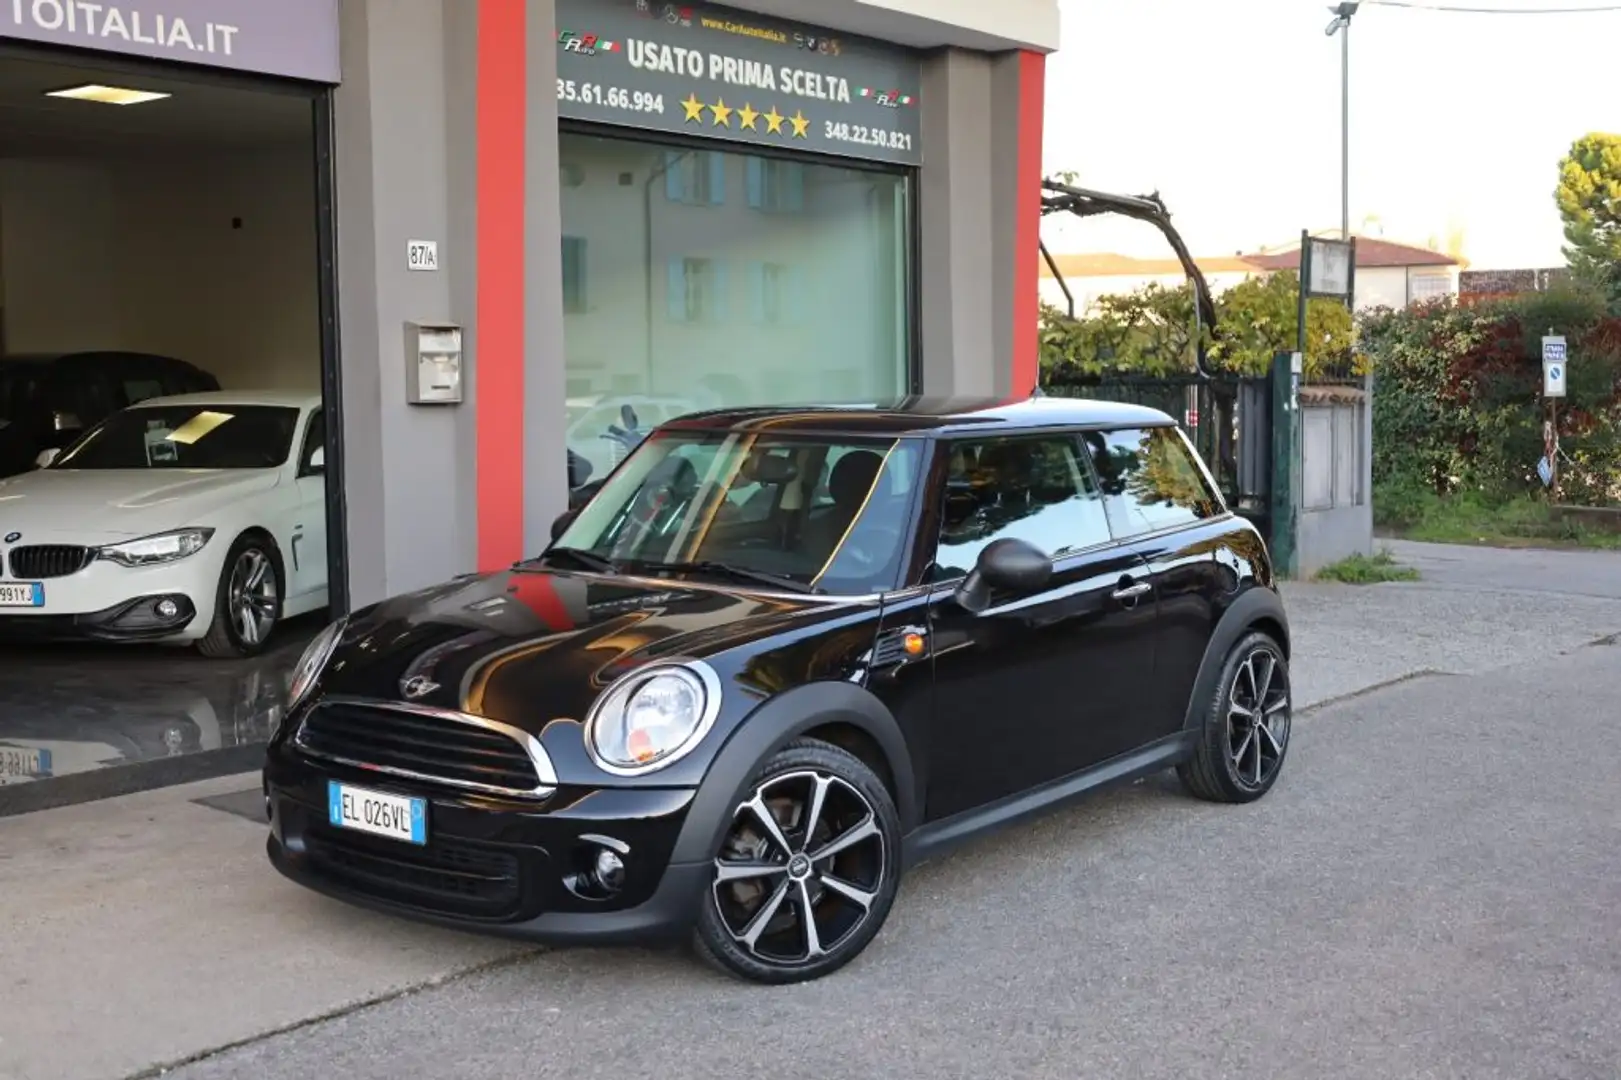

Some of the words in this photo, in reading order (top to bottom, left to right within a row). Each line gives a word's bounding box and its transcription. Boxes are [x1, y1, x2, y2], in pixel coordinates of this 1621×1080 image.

[627, 38, 704, 78] USATO
[709, 54, 776, 91] PRIMA
[780, 67, 851, 103] SCELTA
[824, 120, 912, 150] 348.22.50.821
[410, 246, 435, 265] 87/A
[342, 793, 360, 822] EL
[364, 799, 410, 833] 026VL
